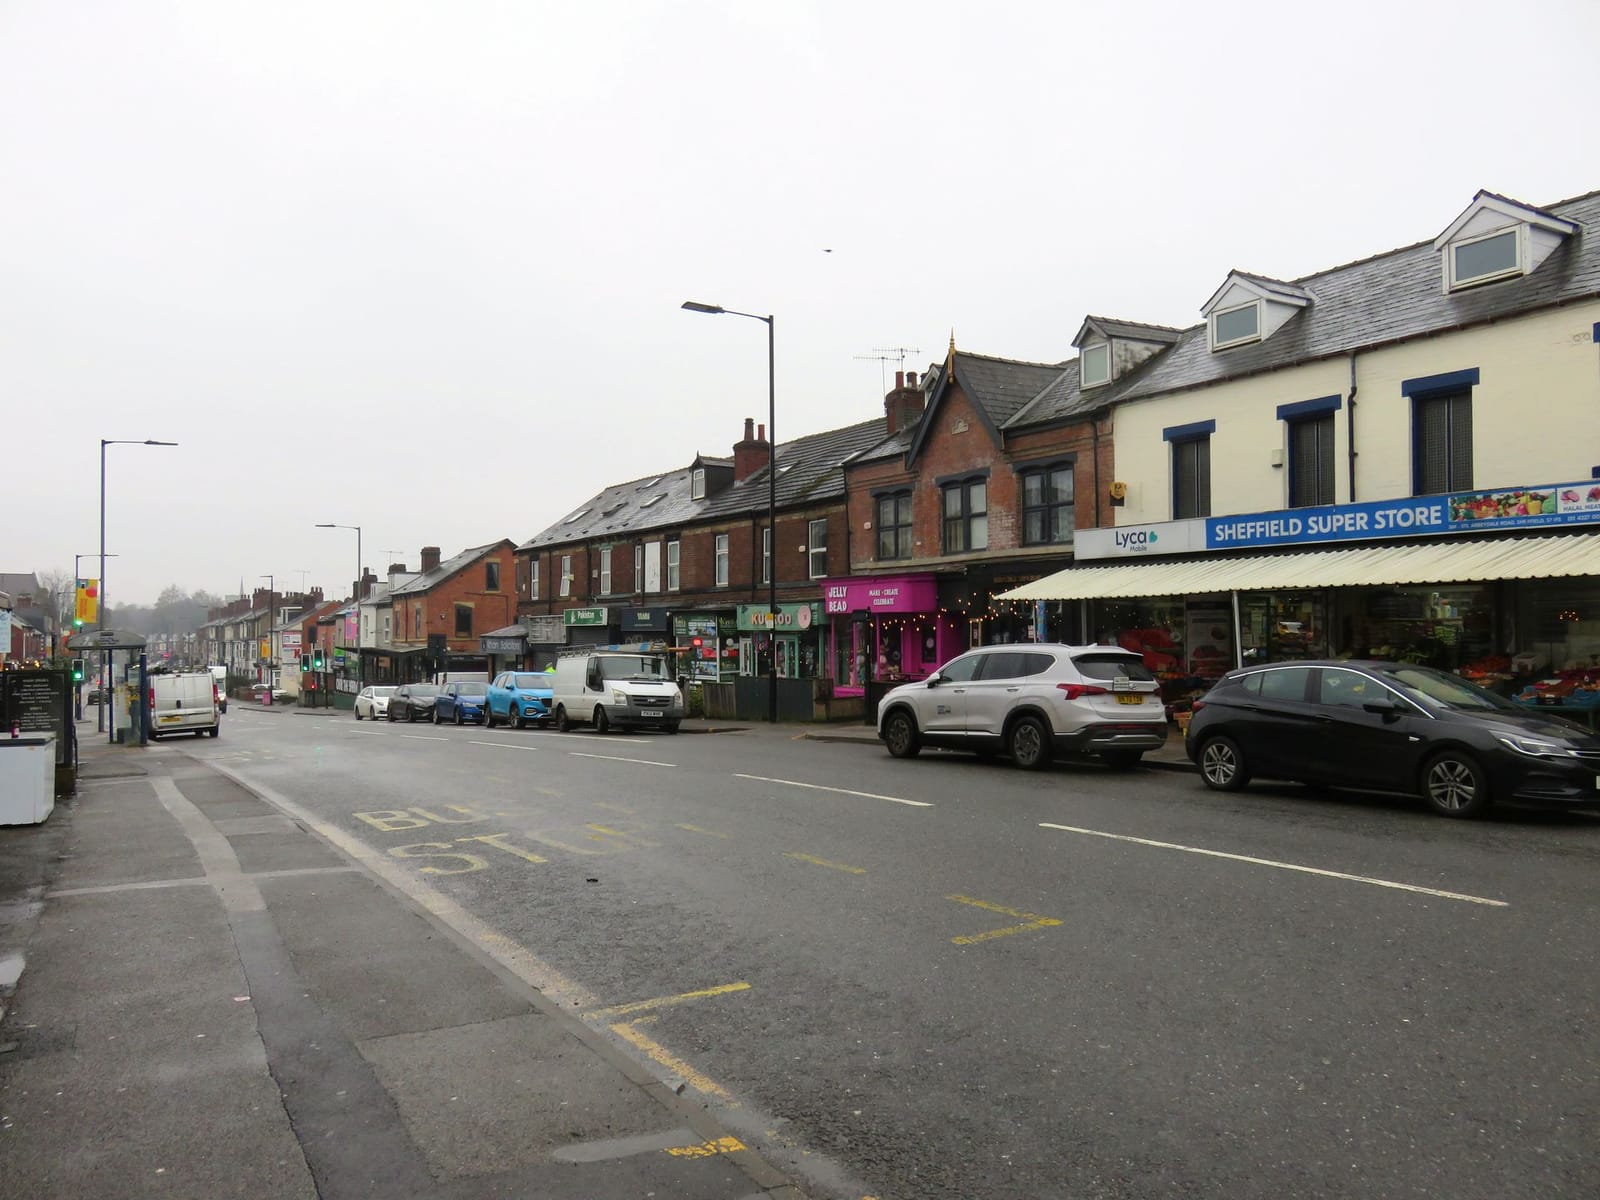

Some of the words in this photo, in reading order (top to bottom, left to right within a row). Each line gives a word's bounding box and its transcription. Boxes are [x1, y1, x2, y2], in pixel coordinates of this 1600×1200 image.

[1215, 519, 1303, 542] SHEFFIELD
[1307, 511, 1369, 535] SUPER
[1374, 505, 1443, 530] STORE
[1115, 530, 1147, 548] Lyca
[829, 586, 847, 598] JELLY
[829, 601, 847, 612] BEAD
